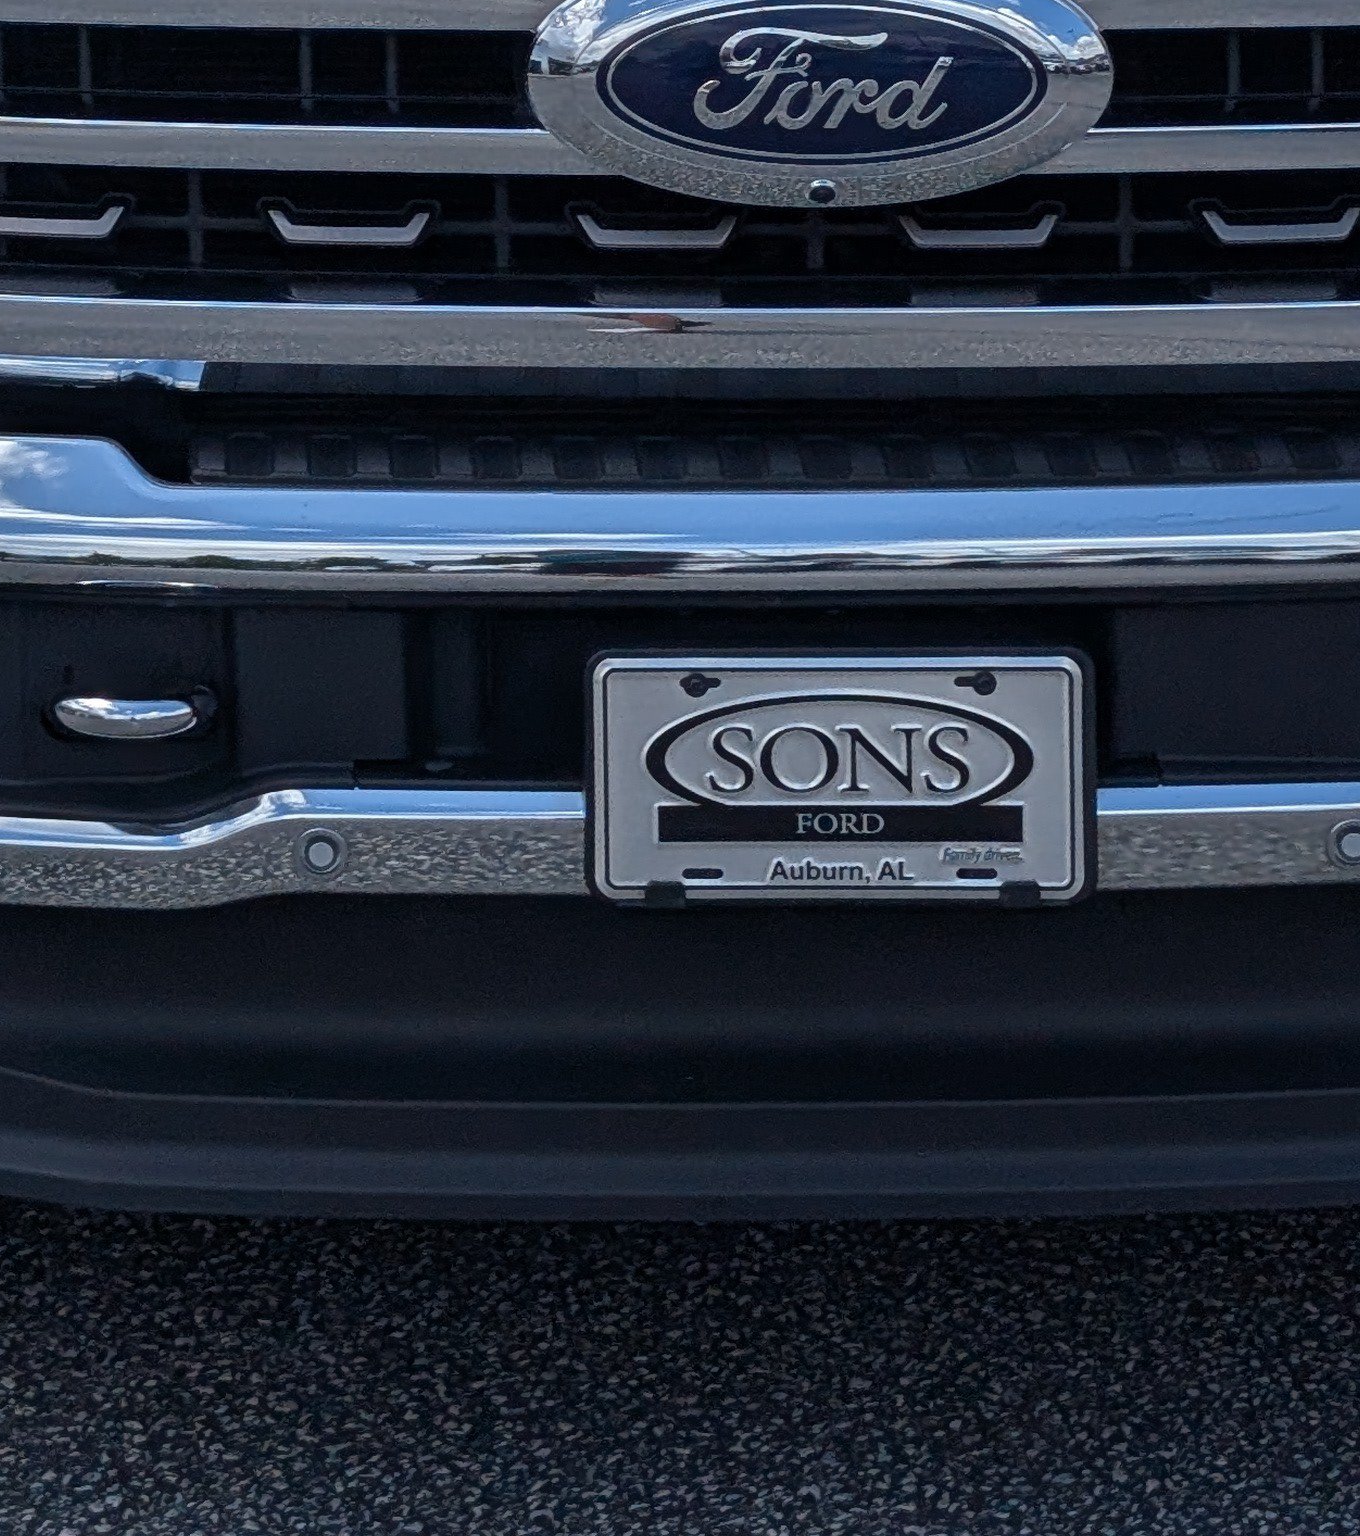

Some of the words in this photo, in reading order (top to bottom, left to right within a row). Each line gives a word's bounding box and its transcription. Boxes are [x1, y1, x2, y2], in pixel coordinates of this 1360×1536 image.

[692, 26, 954, 131] Ford
[706, 725, 971, 794] SONS
[796, 812, 885, 835] FORD
[769, 860, 871, 884] Auburn,
[877, 860, 915, 881] AL
